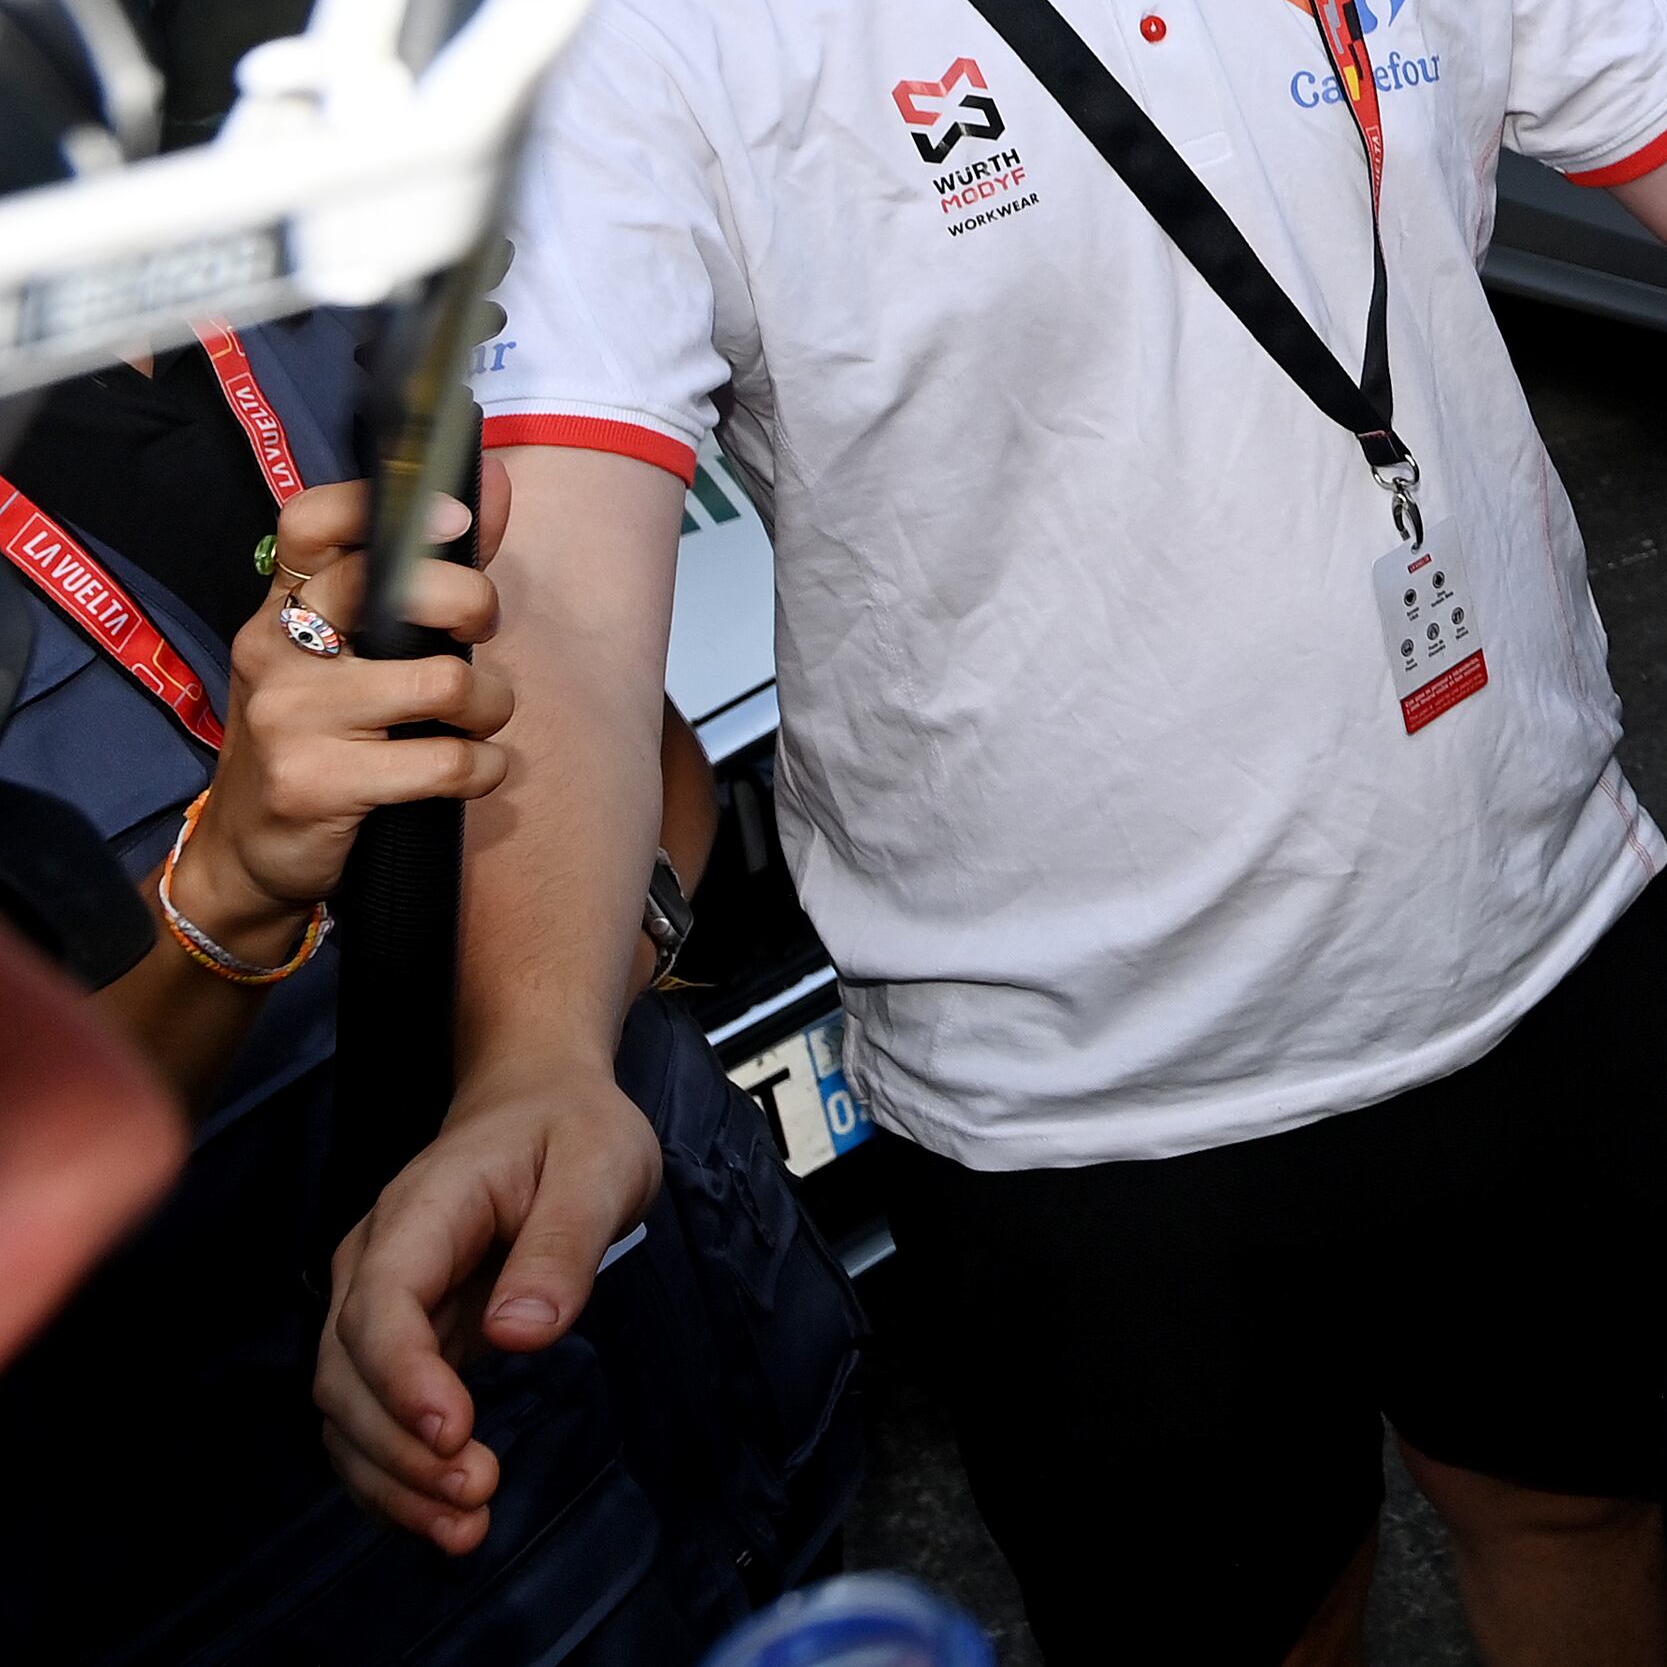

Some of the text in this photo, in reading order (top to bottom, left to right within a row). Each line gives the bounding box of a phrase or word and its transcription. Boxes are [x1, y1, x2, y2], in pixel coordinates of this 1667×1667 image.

[1291, 51, 1440, 109] Caefour
[933, 148, 1021, 195] WÜRTH
[940, 167, 1026, 214] MODYF
[948, 192, 1040, 237] WORKWEAR
[236, 385, 284, 463] VUELTA
[23, 531, 131, 636] LA VUELTA
